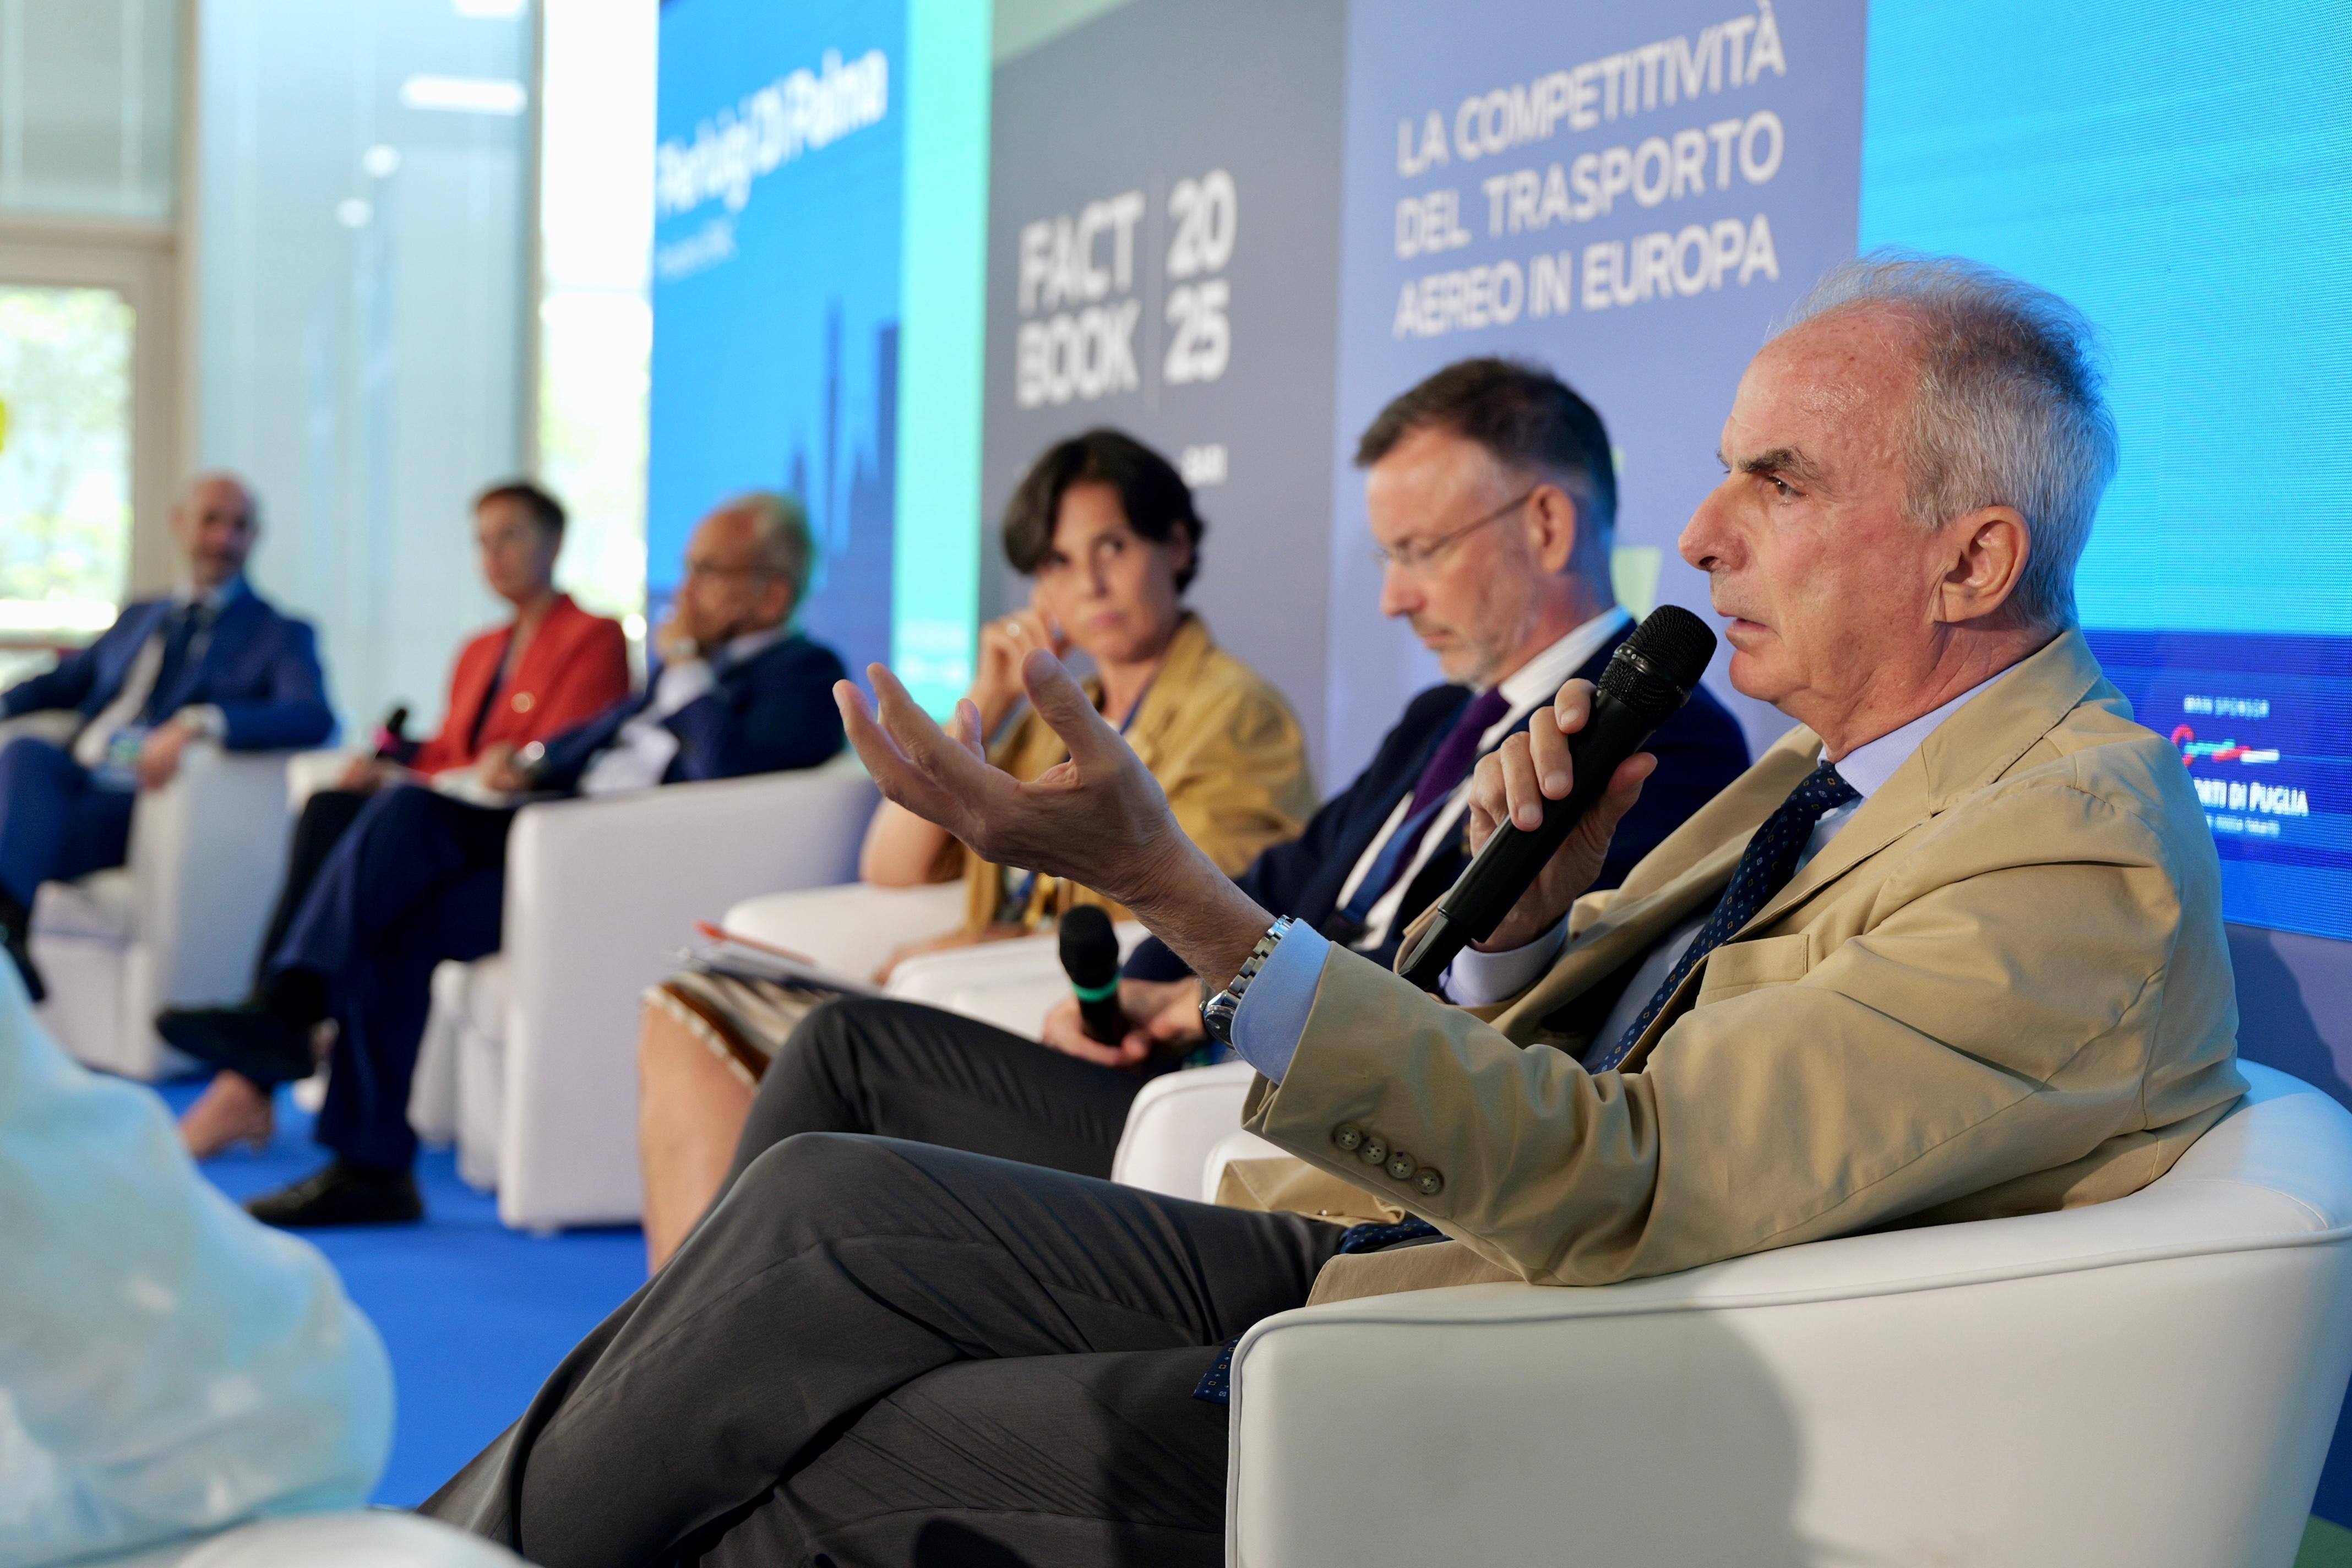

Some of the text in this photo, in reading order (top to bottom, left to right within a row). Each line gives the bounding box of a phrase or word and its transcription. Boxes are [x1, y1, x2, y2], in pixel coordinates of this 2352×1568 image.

[1397, 0, 1787, 177] LA COMPETITIVITÀ
[1166, 168, 1237, 278] 20
[1395, 110, 1784, 260] DEL TRASPORTO
[1019, 190, 1146, 315] FACT
[1393, 213, 1779, 340] AEREO IN EUROPA
[1017, 298, 1140, 410] BOOK
[1163, 279, 1231, 385] 25
[2249, 781, 2310, 816] PUGLIA
